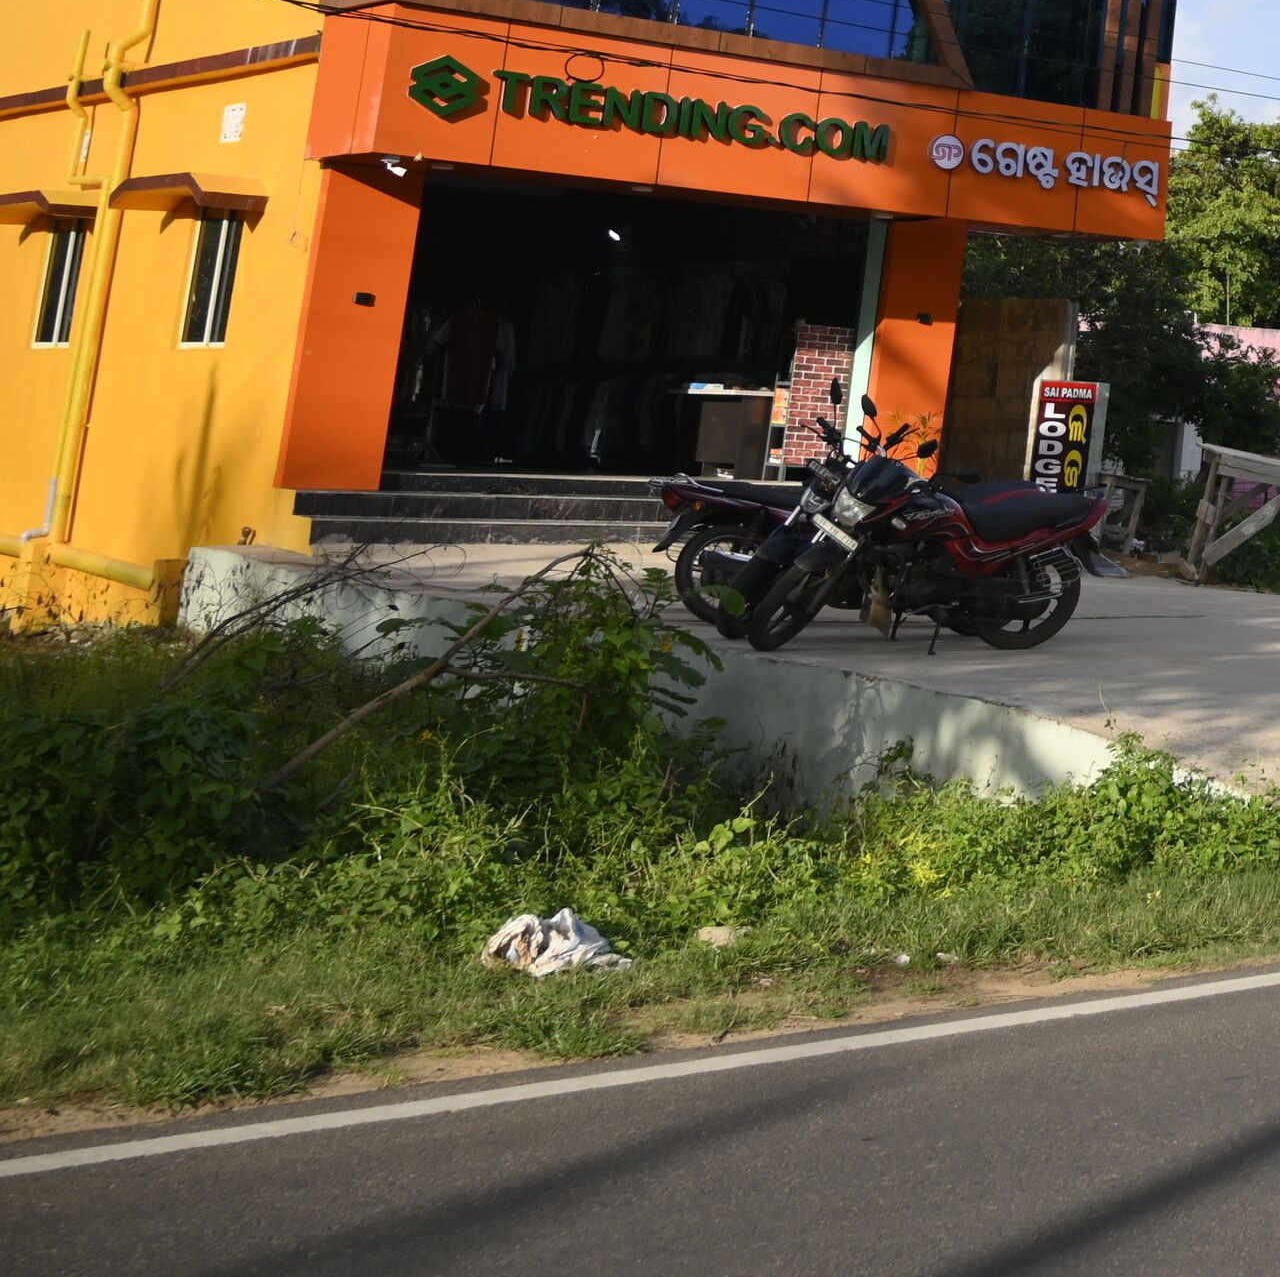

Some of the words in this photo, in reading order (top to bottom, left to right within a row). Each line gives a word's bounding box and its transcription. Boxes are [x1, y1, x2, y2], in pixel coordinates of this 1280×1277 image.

[492, 70, 890, 161] TRENDING.COM
[971, 138, 1059, 189] ଗେଷ୍ଟ
[1065, 151, 1159, 207] ହାଉସ୍
[1044, 387, 1060, 398] SAI
[1061, 387, 1093, 399] PADMA
[1034, 403, 1067, 494] LODGE
